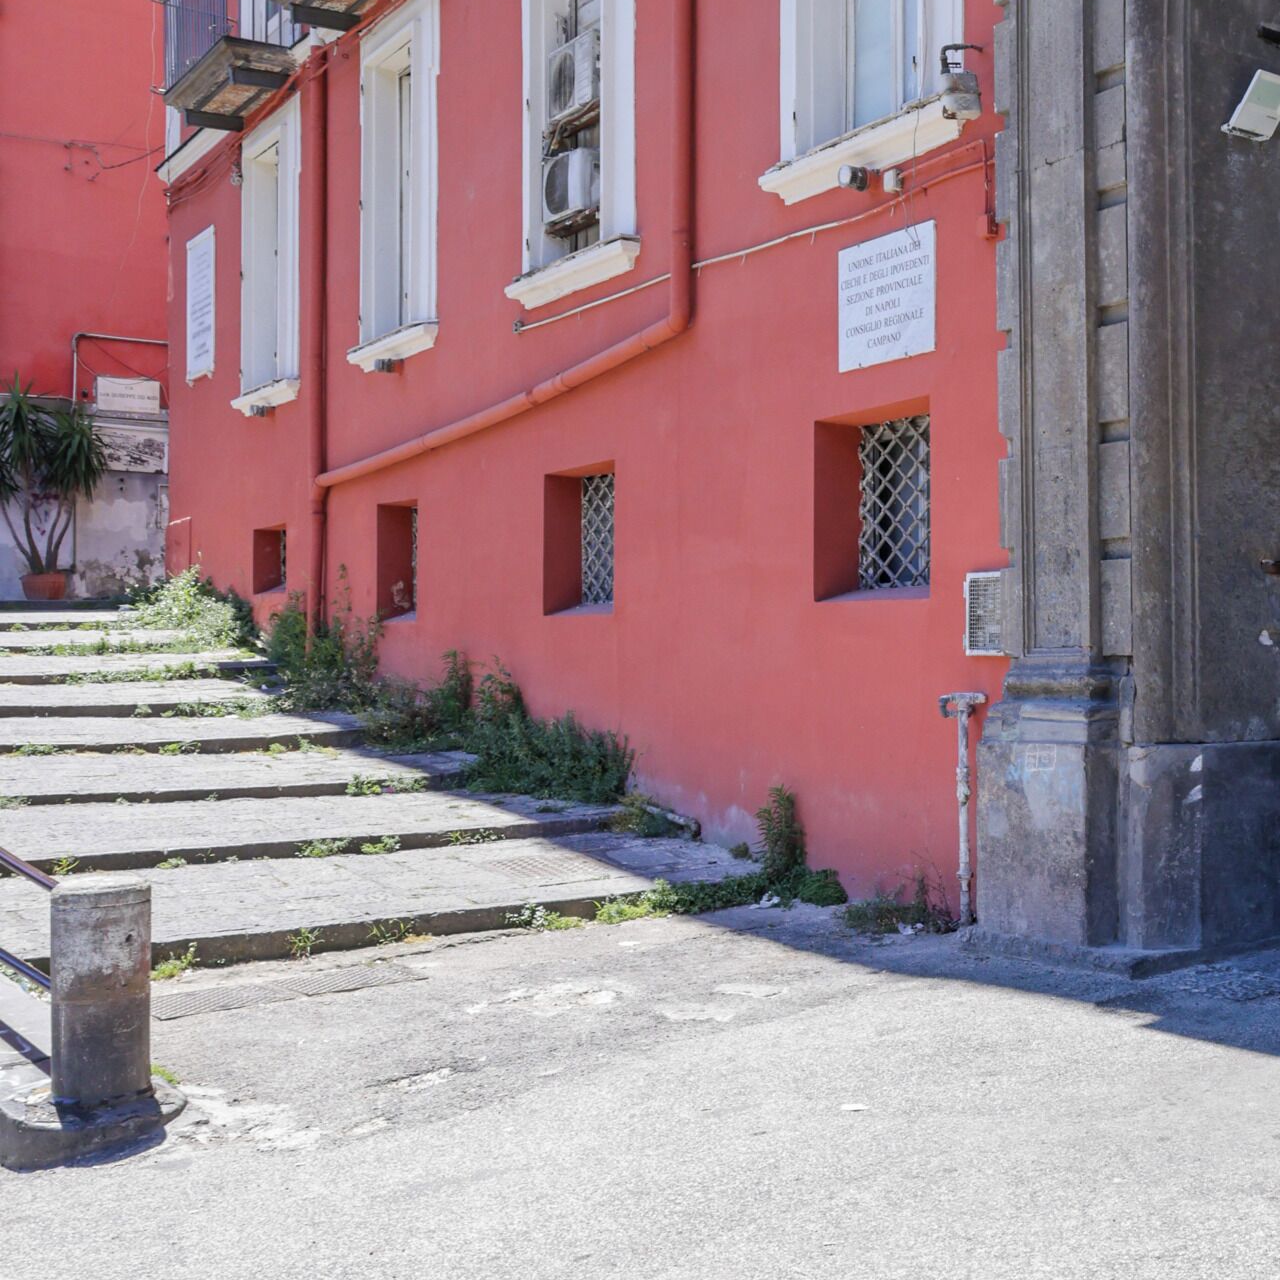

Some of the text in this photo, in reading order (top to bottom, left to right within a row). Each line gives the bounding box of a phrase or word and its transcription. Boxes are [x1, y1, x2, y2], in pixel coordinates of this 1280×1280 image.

[841, 254, 930, 291] CIECHI E DEGLI IPOVEDENTI
[848, 256, 874, 272] UNIONE
[876, 245, 908, 264] ITALIANA
[846, 274, 923, 306] SEZIONE PROVINCIALE
[865, 297, 900, 317] DI NAPOLI
[846, 307, 924, 339] CONSIGLIO REGIONALE
[867, 331, 901, 349] CAMPANO
